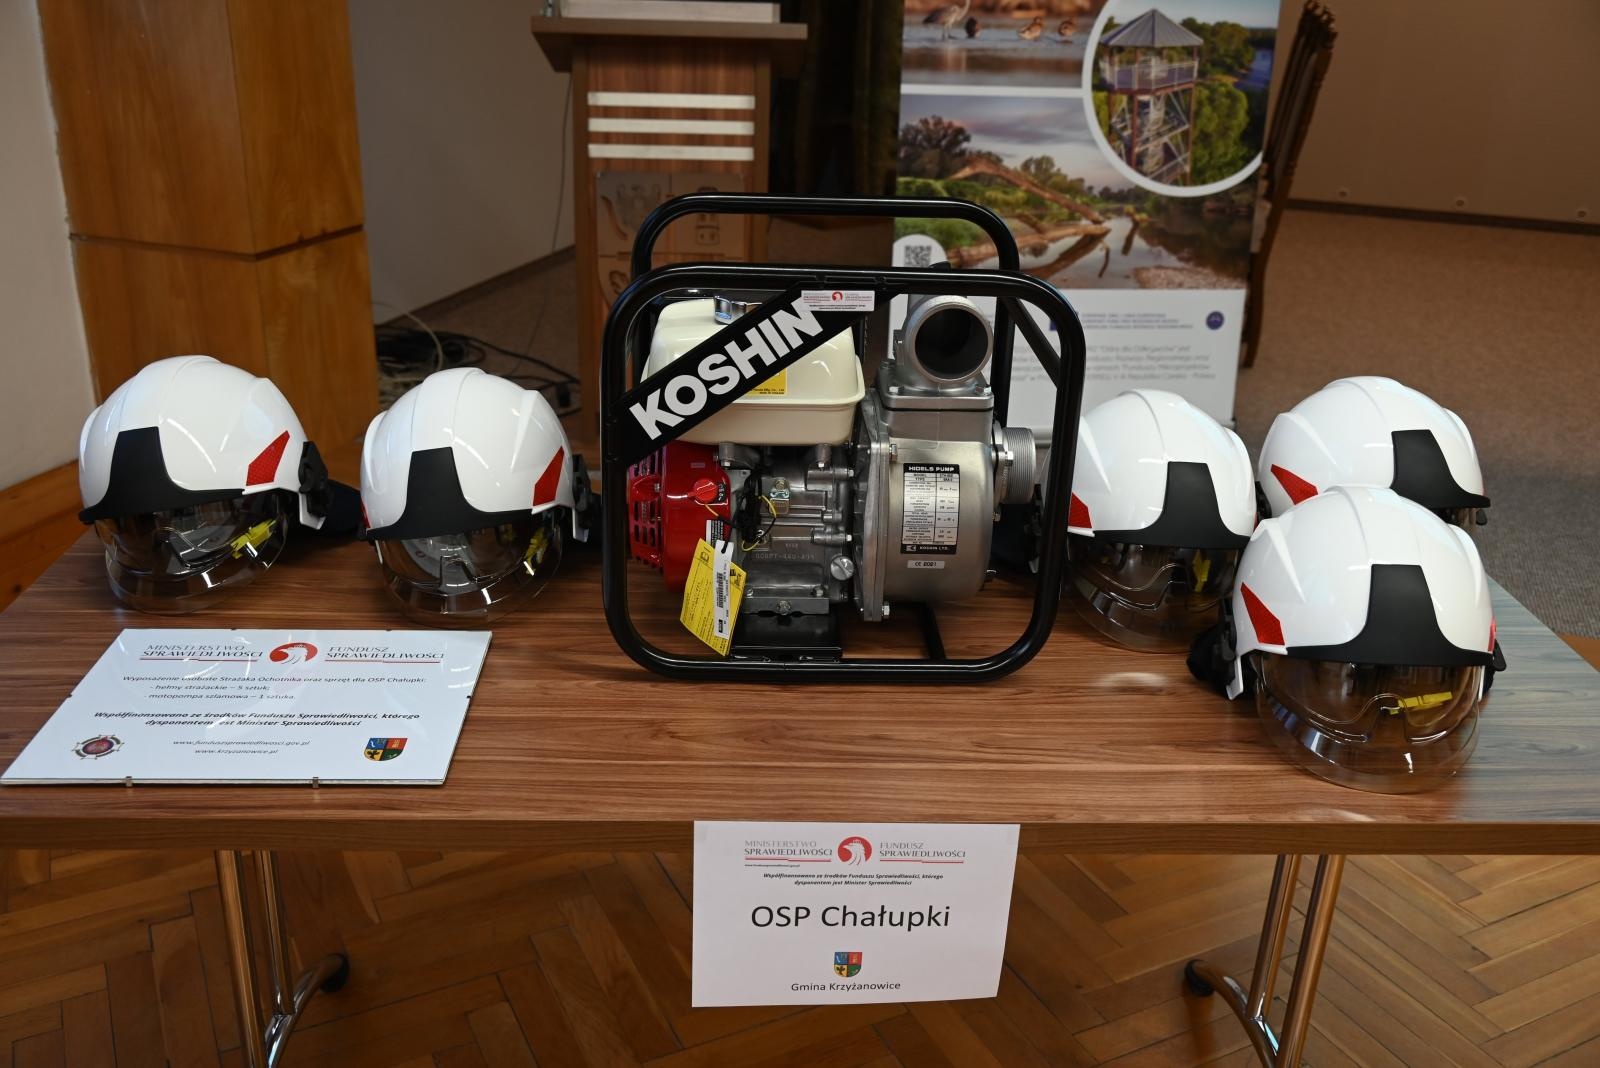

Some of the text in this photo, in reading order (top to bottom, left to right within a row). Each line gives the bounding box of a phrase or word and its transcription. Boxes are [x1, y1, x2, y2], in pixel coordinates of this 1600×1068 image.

[629, 297, 824, 441] KOSHIN
[744, 848, 832, 856] SPRAWIEDLIWOŚCI
[879, 849, 966, 858] SPRAWIEDLIWOŚCI
[751, 905, 950, 932] OSP Chałupki
[791, 982, 901, 993] Gmina Krzyżanowice
